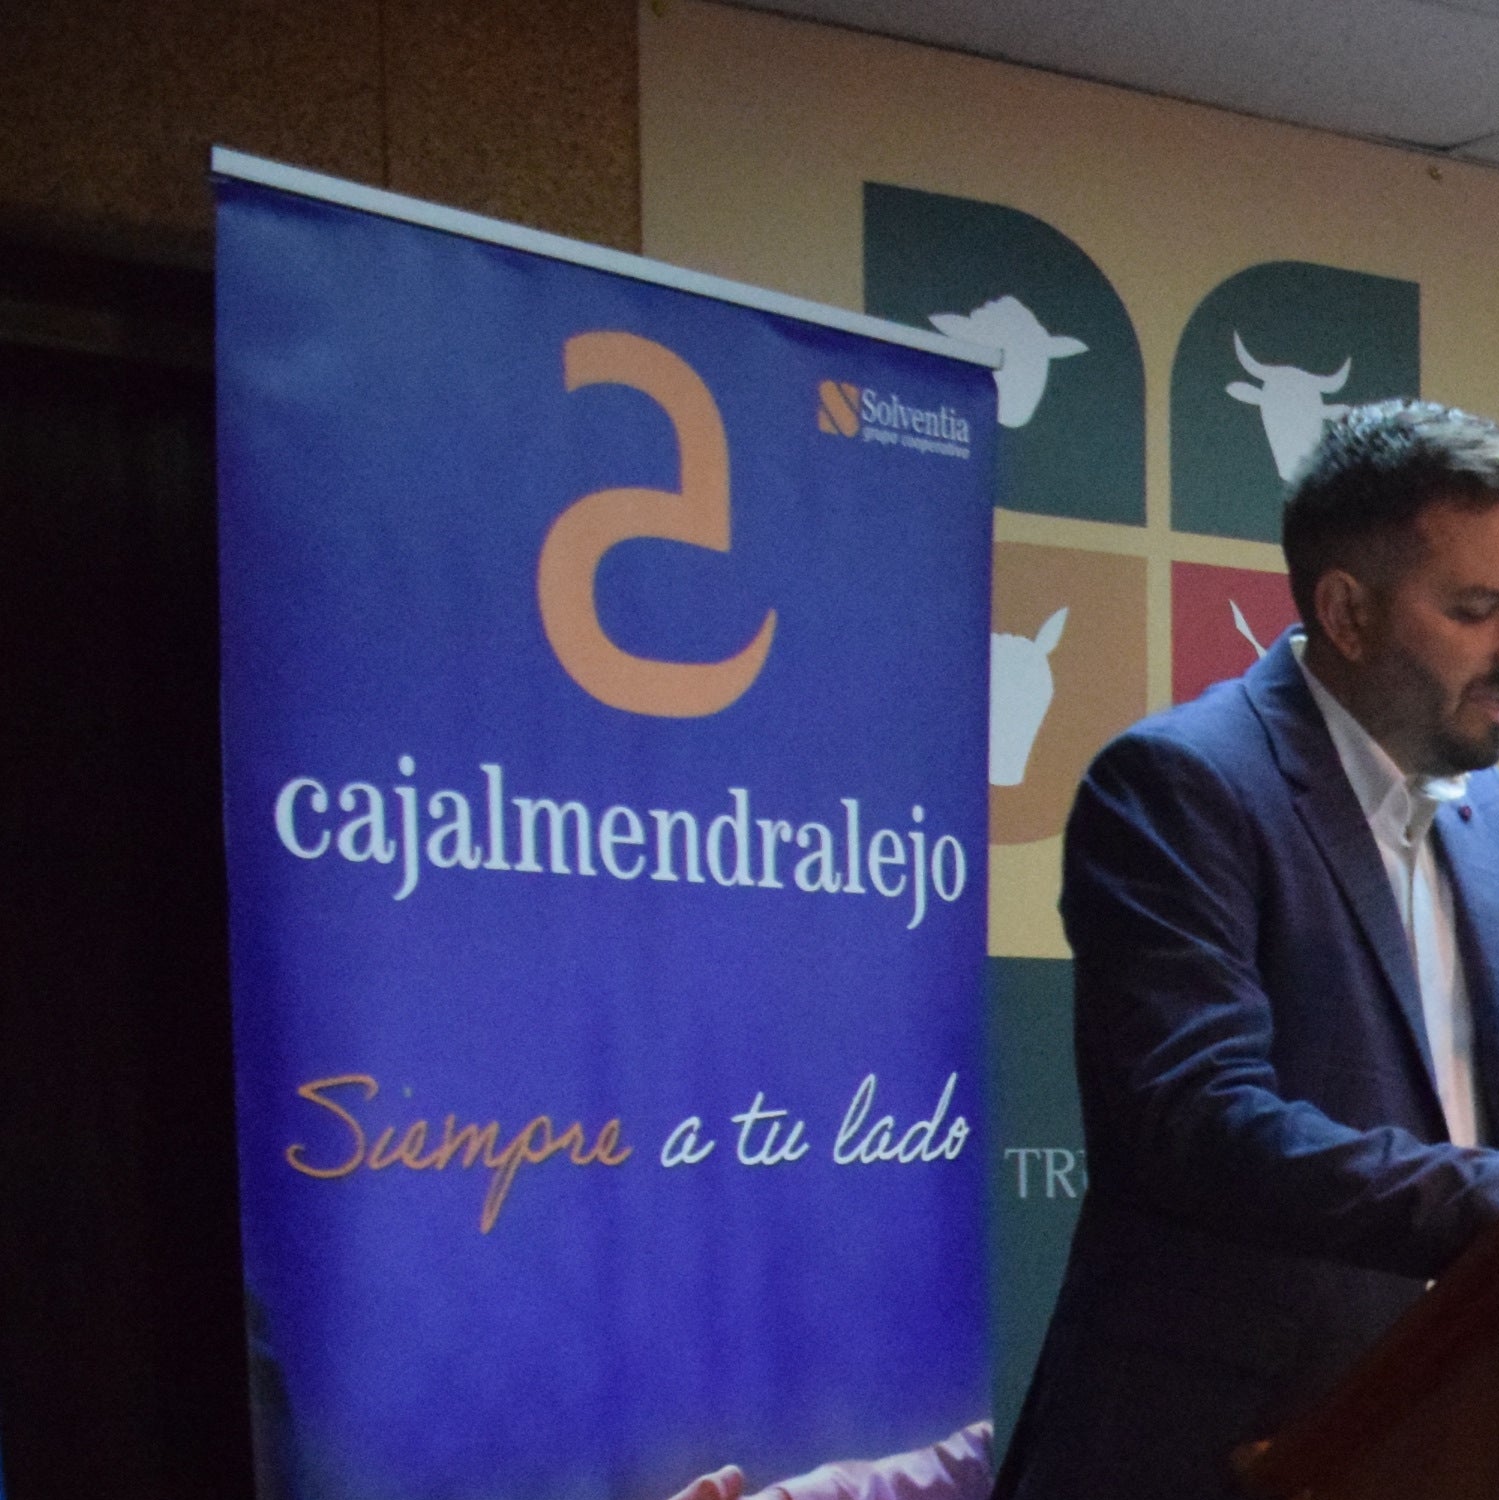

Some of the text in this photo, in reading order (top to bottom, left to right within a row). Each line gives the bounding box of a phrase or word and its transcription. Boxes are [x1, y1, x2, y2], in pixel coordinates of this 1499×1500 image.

[861, 387, 970, 443] Solventia
[275, 756, 966, 930] cajalmendralejo
[286, 1073, 970, 1235] Siempre a tu lado
